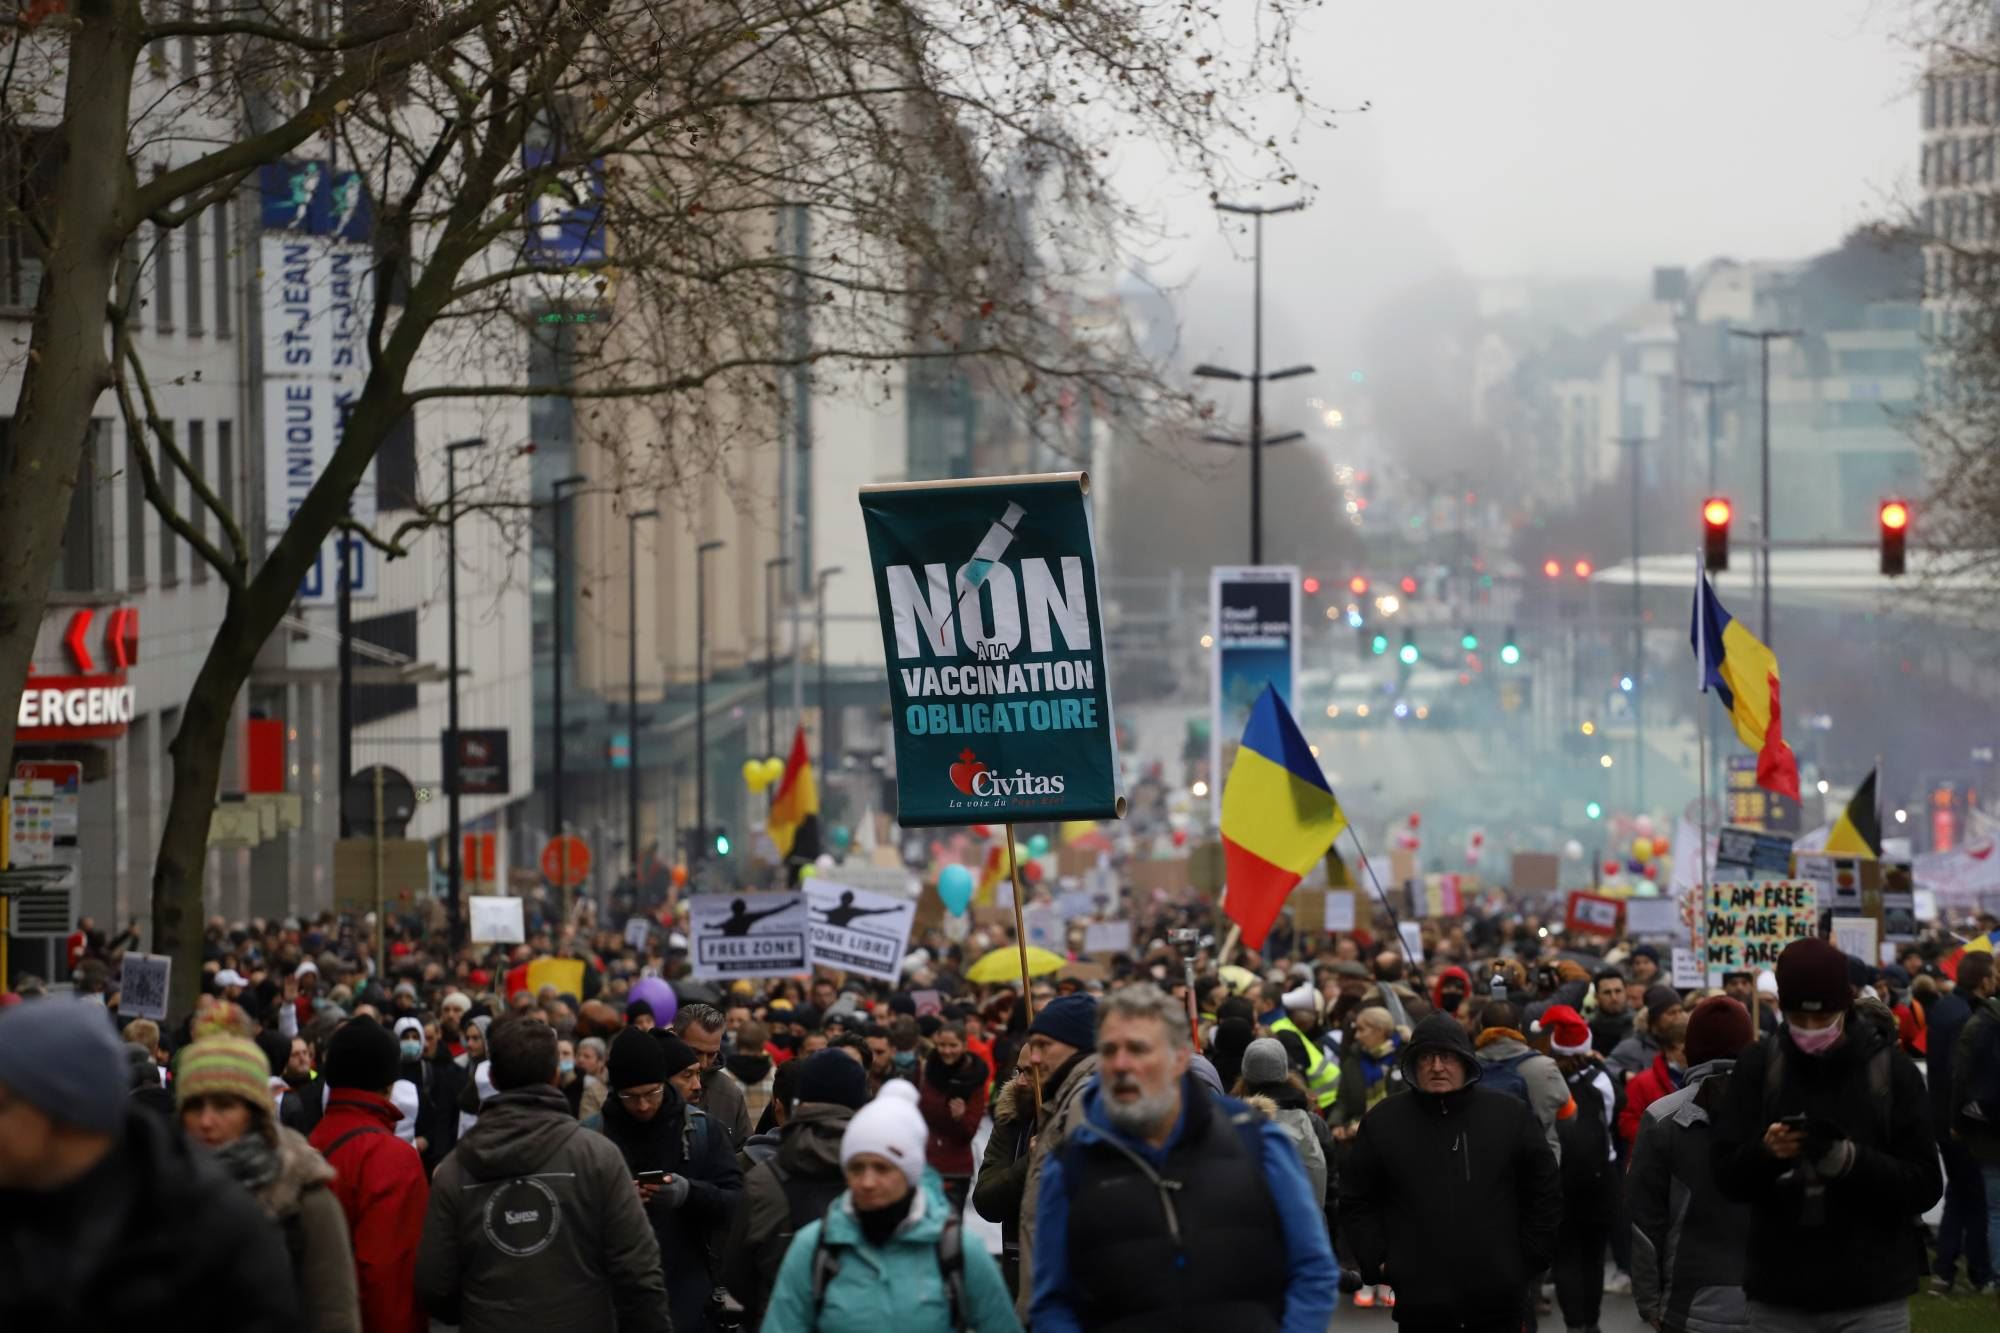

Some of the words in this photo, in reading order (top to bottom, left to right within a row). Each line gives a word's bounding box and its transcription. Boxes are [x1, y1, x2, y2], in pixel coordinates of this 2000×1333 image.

[886, 556, 1091, 658] NON
[989, 643, 1010, 660] LA
[900, 660, 1095, 697] VACCINATION
[17, 686, 136, 727] ERGENC
[906, 697, 1098, 736] OBLIGATOIRE
[971, 768, 1065, 797] Civitas
[949, 799, 962, 808] La
[966, 799, 990, 808] voix
[994, 797, 1007, 807] du
[1730, 886, 1755, 907] AM
[1764, 886, 1804, 908] FREE
[1707, 912, 1736, 938] YOU
[1745, 913, 1778, 937] ARE
[708, 942, 746, 957] FREE
[752, 939, 795, 955] ZONE
[850, 936, 892, 957] LIBRE
[1707, 943, 1734, 964] WE
[1744, 943, 1778, 965] ARE
